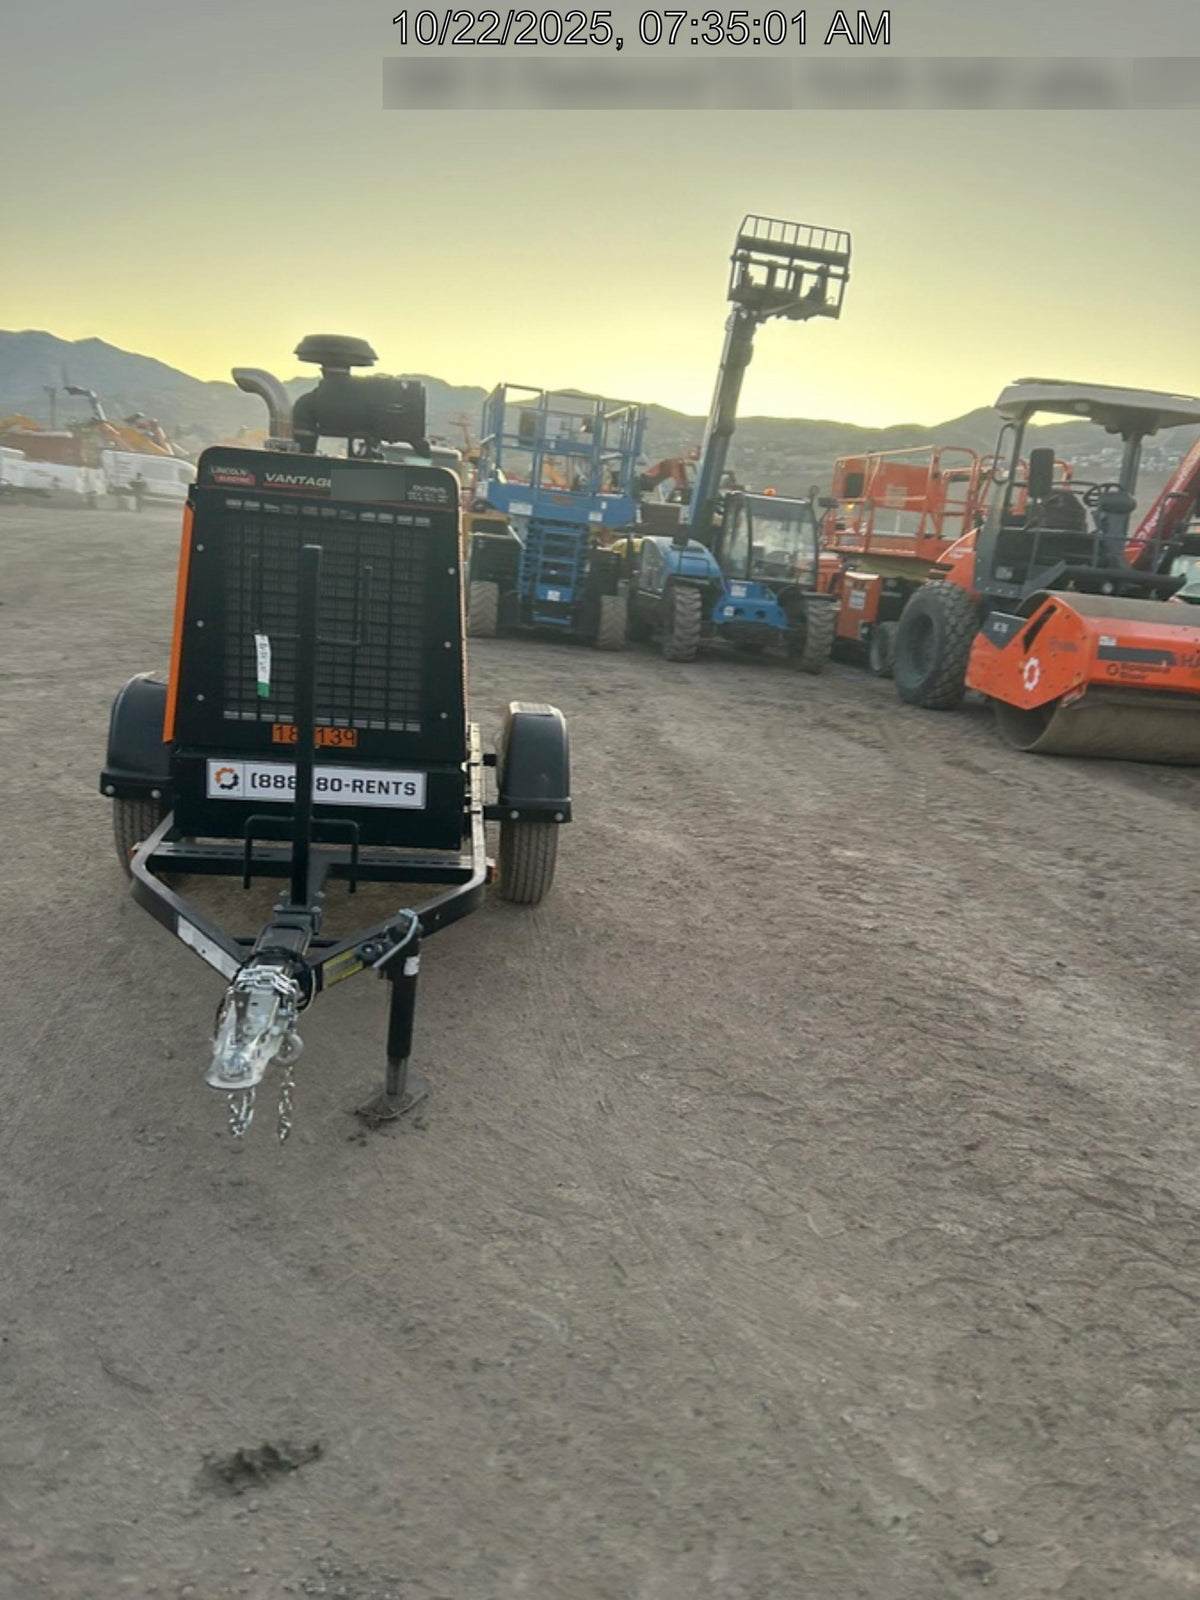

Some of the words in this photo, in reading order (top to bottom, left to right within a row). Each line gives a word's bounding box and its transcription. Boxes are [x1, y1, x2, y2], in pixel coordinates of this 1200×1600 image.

[274, 725, 356, 747] 18139
[251, 772, 297, 789] (888
[315, 776, 417, 796] 80-RENTS
